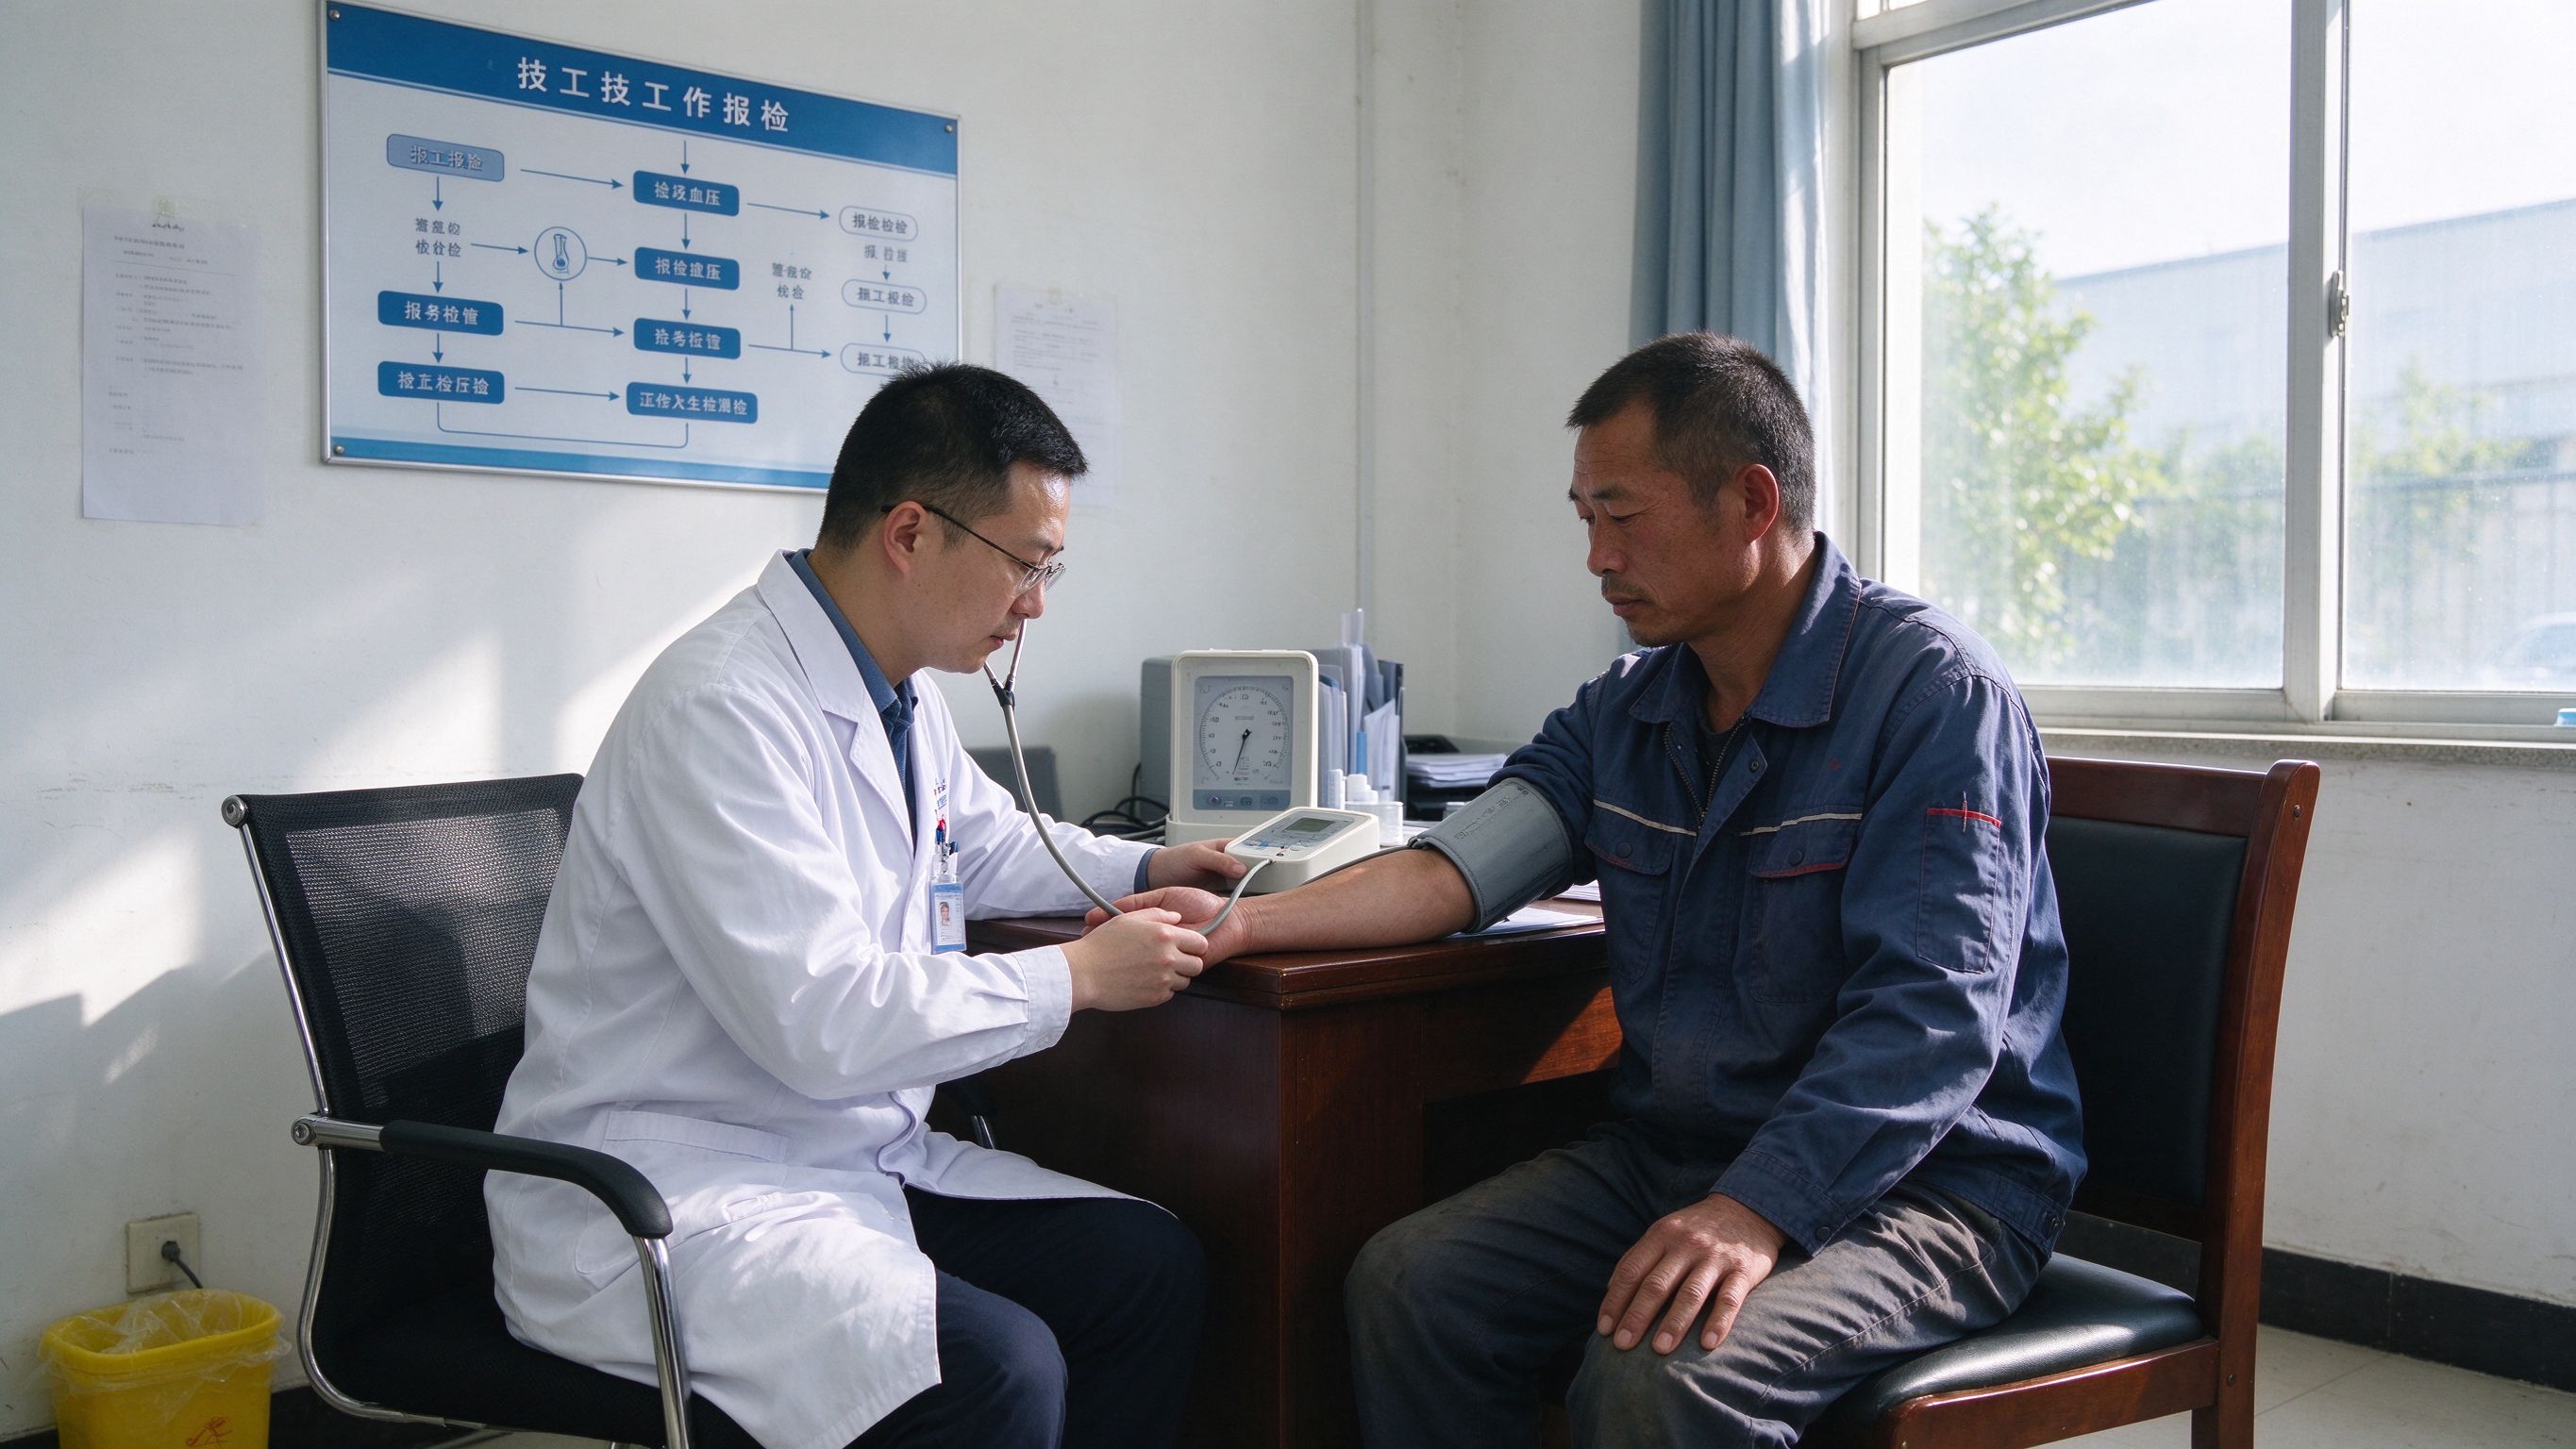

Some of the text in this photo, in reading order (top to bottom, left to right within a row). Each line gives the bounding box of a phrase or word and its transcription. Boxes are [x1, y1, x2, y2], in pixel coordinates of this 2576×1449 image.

[518, 57, 790, 133] 技工技工作报检
